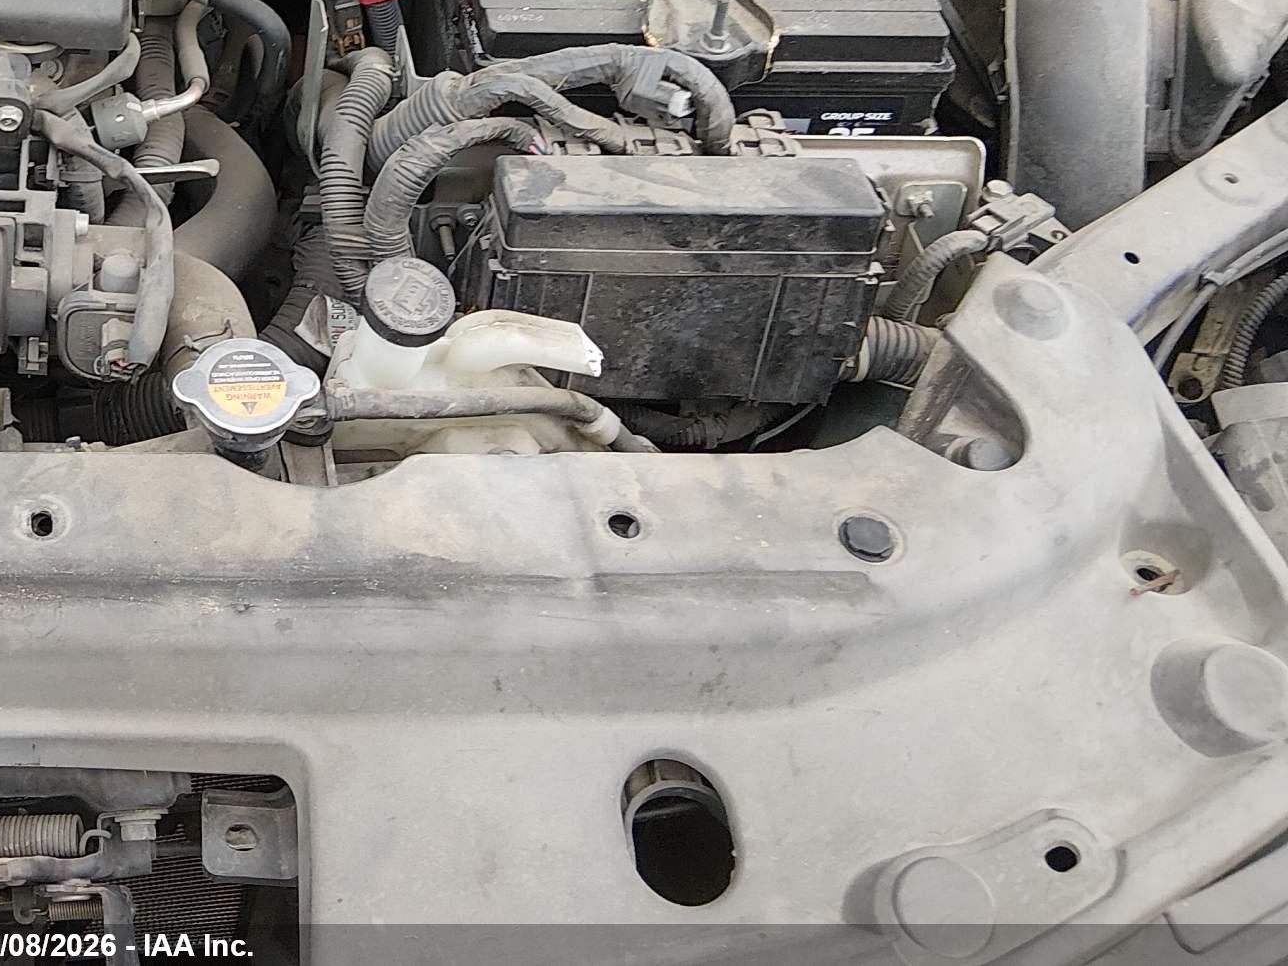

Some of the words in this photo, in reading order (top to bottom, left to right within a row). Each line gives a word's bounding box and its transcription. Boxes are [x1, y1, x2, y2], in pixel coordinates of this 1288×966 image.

[820, 112, 864, 121] GROUP
[864, 112, 894, 121] SIZE
[213, 384, 281, 393] AVERTISSEMENT
[225, 392, 272, 401] WARNING
